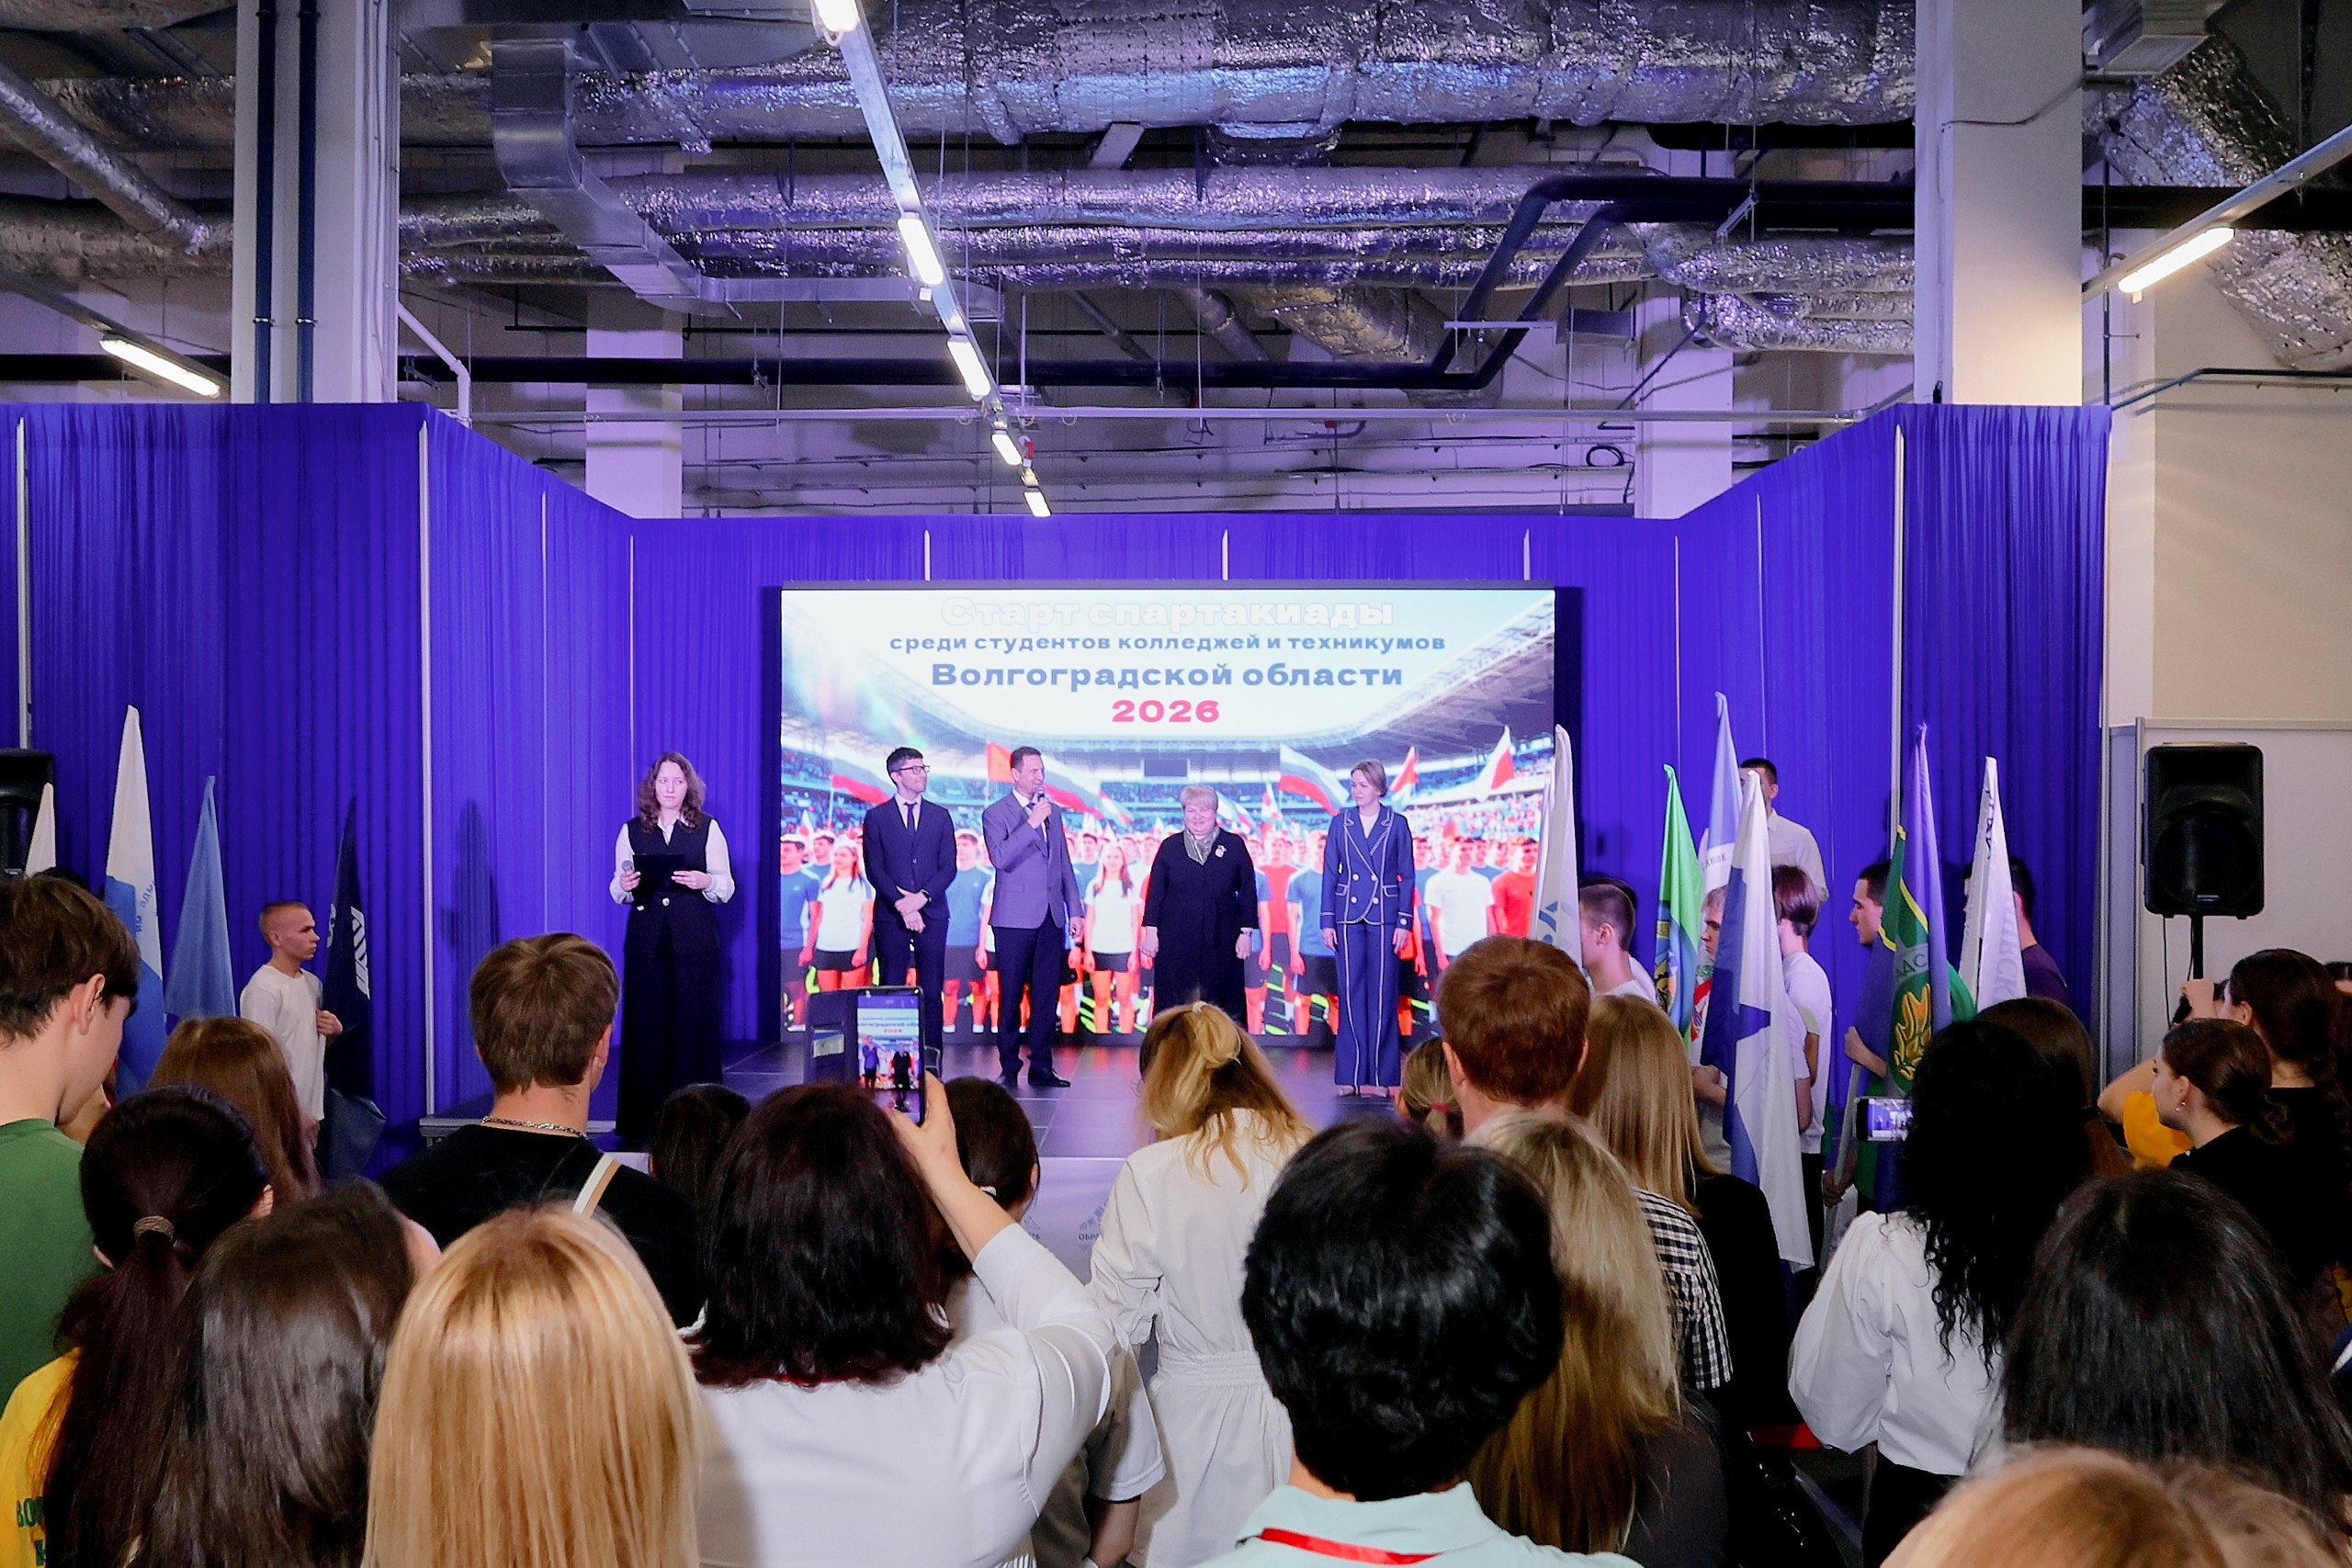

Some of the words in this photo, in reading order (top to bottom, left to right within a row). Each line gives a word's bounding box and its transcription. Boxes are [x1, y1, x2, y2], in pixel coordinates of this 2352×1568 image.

[943, 597, 1078, 632] Старт
[1090, 602, 1393, 631] спартакиады
[889, 637, 967, 653] среди
[974, 637, 1110, 653] студентов
[1118, 634, 1260, 651] колледжей
[1267, 637, 1281, 649] и
[1287, 636, 1445, 653] техникумов
[932, 663, 1231, 691] Волгоградской
[1242, 663, 1402, 686] области
[1113, 700, 1221, 723] 2026
